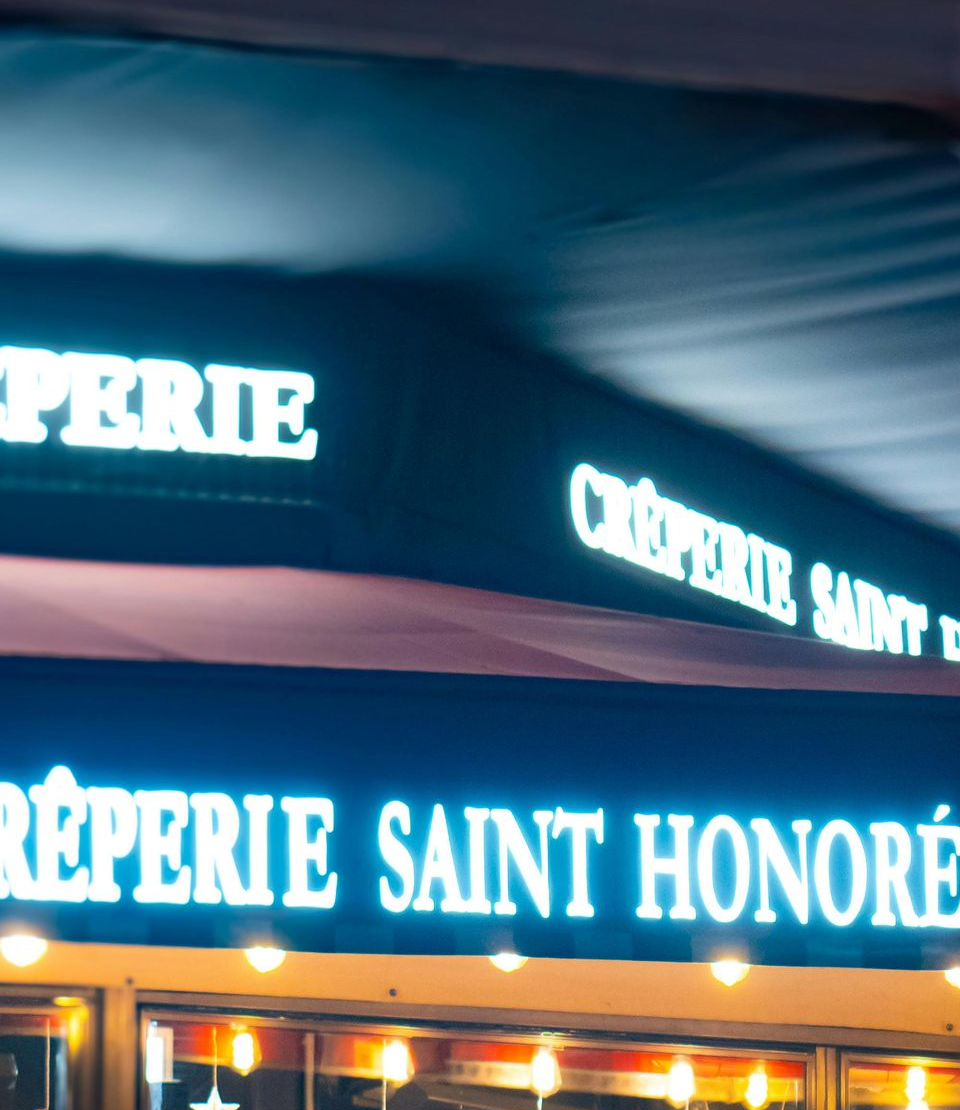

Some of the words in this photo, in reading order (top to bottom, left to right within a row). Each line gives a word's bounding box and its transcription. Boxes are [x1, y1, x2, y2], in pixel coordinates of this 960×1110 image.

[0, 345, 319, 461] PERIE
[570, 463, 798, 626] CRÊPERIE
[810, 562, 928, 656] SAINT
[378, 800, 605, 919] SAINT
